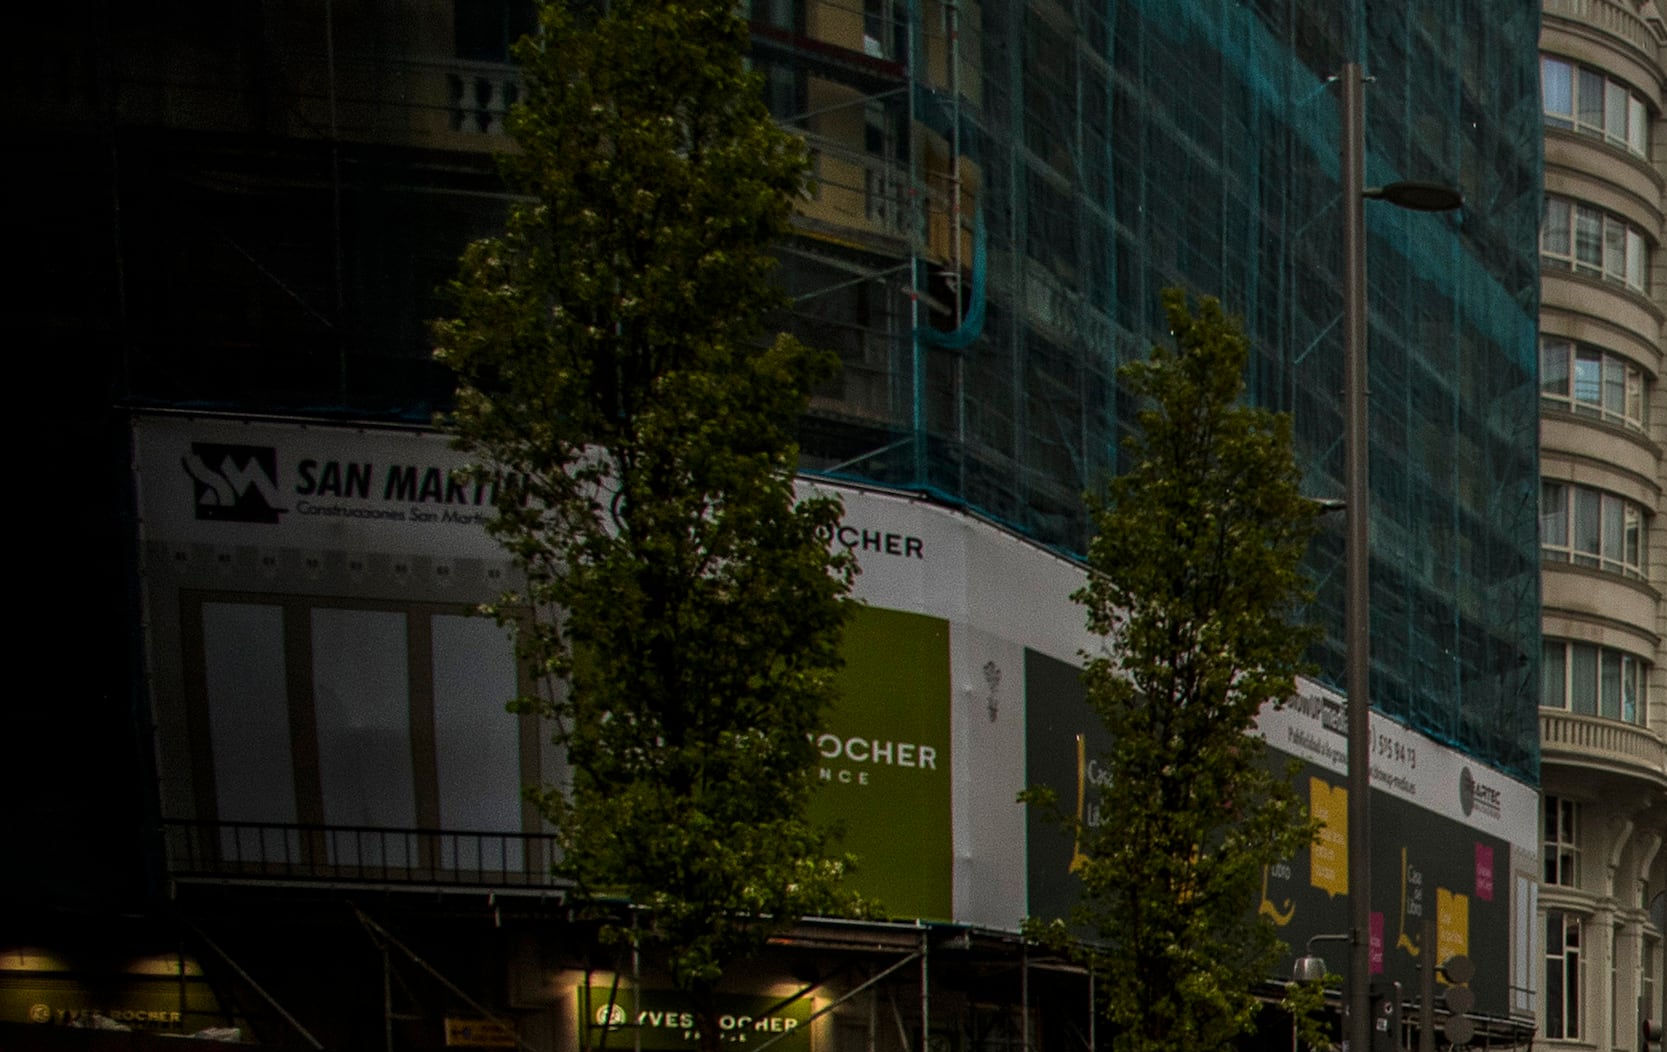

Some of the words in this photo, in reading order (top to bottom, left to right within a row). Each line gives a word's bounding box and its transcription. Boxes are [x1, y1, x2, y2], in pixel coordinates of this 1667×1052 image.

[295, 459, 372, 498] SAN
[409, 508, 438, 523] San
[806, 731, 938, 771] OCHER
[55, 1008, 104, 1024] YVES
[110, 1008, 182, 1023] ROCHER
[637, 1010, 696, 1029] YVES
